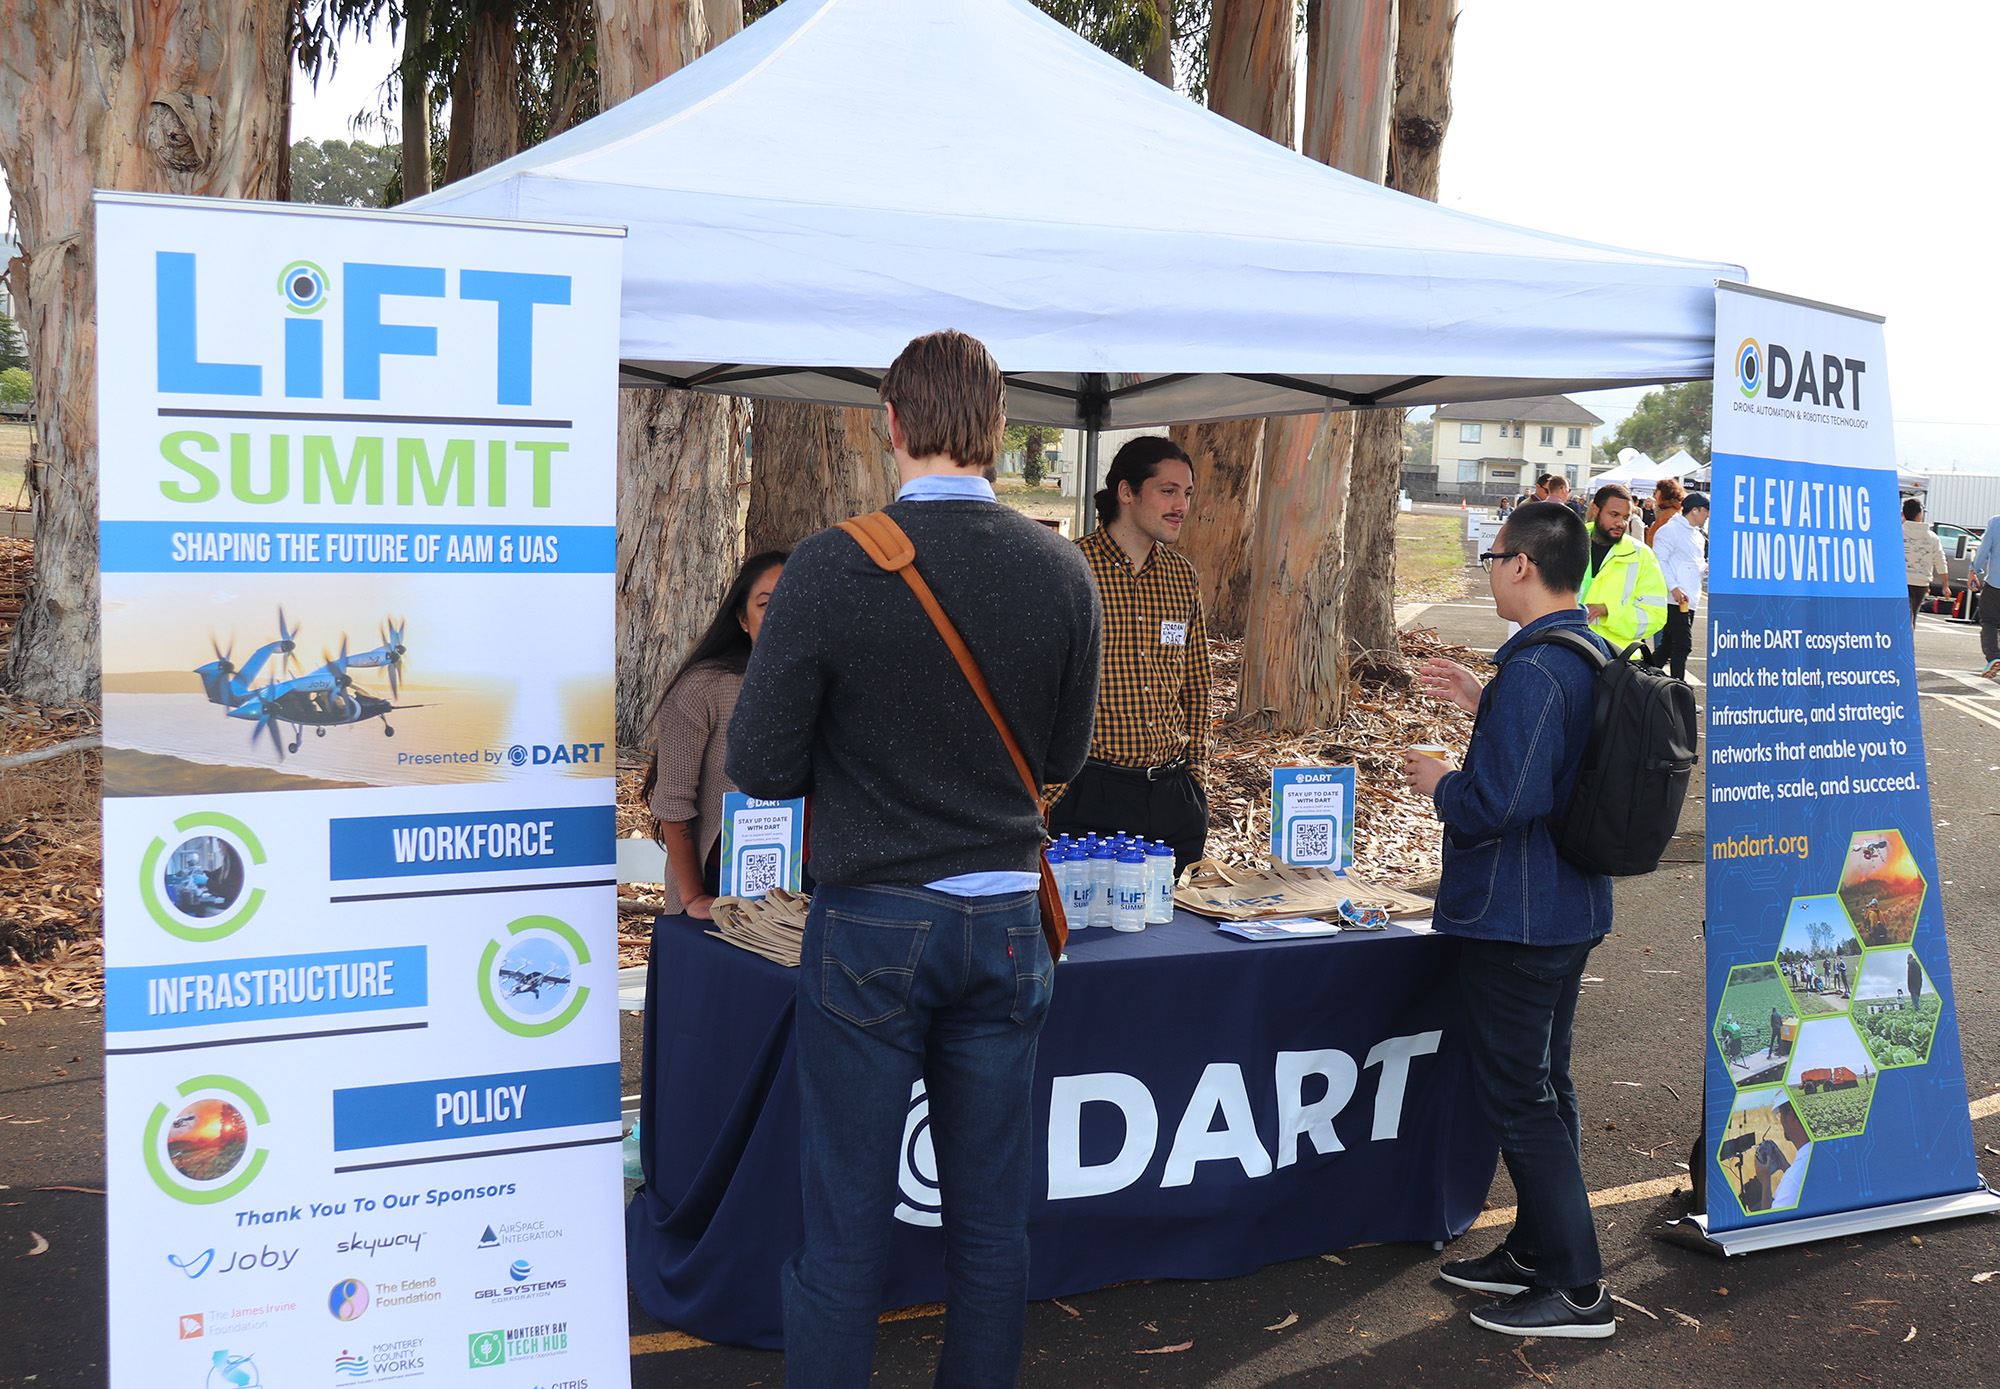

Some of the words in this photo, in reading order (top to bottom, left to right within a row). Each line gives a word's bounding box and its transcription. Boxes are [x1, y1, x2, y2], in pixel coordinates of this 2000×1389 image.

[1767, 344, 1865, 411] DART
[1733, 402, 1755, 414] DRONE,
[1756, 405, 1796, 419] AUTOMATION
[1796, 411, 1802, 420] &
[1803, 411, 1830, 424] ROBOTICS
[1830, 415, 1869, 429] TECHNOLOGY
[159, 430, 570, 508] SUMMIT
[1733, 475, 1871, 532] ELEVATING
[172, 532, 271, 563] SHAPING
[276, 533, 320, 562] THE
[326, 533, 409, 563] FUTURE
[414, 534, 441, 563] OF
[446, 534, 493, 563] AAM
[499, 535, 514, 563] &
[518, 535, 559, 563] UAS
[1732, 530, 1875, 584] INNOVATION
[1711, 620, 1738, 657] Join
[1741, 630, 1762, 649] the
[1764, 629, 1803, 649] DART
[1805, 631, 1873, 655] ecosystem
[1875, 631, 1892, 649] to
[1712, 668, 1755, 688] unlock
[1757, 668, 1779, 687] the
[1781, 667, 1825, 689] talent,
[1827, 668, 1901, 688] resources,
[1711, 704, 1808, 727] infrastructure,
[1810, 703, 1836, 723] and
[1838, 701, 1905, 726] strategic
[398, 750, 479, 765] Presented
[484, 750, 503, 765] by
[532, 743, 605, 765] DART
[1711, 743, 1773, 765] networks
[1775, 741, 1806, 761] that
[1808, 739, 1856, 760] enable
[1858, 740, 1888, 763] you
[1890, 738, 1907, 756] to
[1305, 774, 1332, 782] DART
[1711, 780, 1775, 803] innovate,
[1777, 777, 1818, 799] scale,
[1820, 775, 1850, 796] and
[1852, 771, 1921, 794] succeed.
[393, 821, 555, 863] WORKFORCE
[1712, 833, 1809, 860] mbdart.org
[1074, 888, 1090, 901] LiF
[148, 960, 395, 1016] INFRASTRUCTURE
[436, 1084, 528, 1128] POLICY
[1047, 1030, 1443, 1200] DART
[235, 1205, 302, 1228] Thank
[309, 1202, 346, 1218] You
[353, 1198, 376, 1213] To
[383, 1193, 420, 1209] Our
[425, 1182, 517, 1206] Sponsors
[337, 1232, 422, 1258] skyway
[218, 1244, 300, 1273] Joby
[376, 1283, 397, 1294] The
[401, 1277, 436, 1291] Eden8
[474, 1288, 501, 1299] GBL
[503, 1279, 567, 1296] SYSTEMS
[492, 1291, 551, 1303] CORPORATION
[209, 1310, 229, 1320] The
[230, 1305, 265, 1318] James
[266, 1302, 297, 1313] Irvine
[376, 1291, 442, 1308] Foundation
[209, 1320, 268, 1335] Foundation
[506, 1324, 550, 1340] MONTEREY
[552, 1321, 568, 1334] BAY
[373, 1338, 424, 1353] MONTEREY
[373, 1349, 415, 1363] COUNTY
[507, 1337, 539, 1357] TECH
[543, 1333, 568, 1351] HUB
[373, 1357, 424, 1374] WORKS
[552, 1379, 588, 1389] CITRIS
